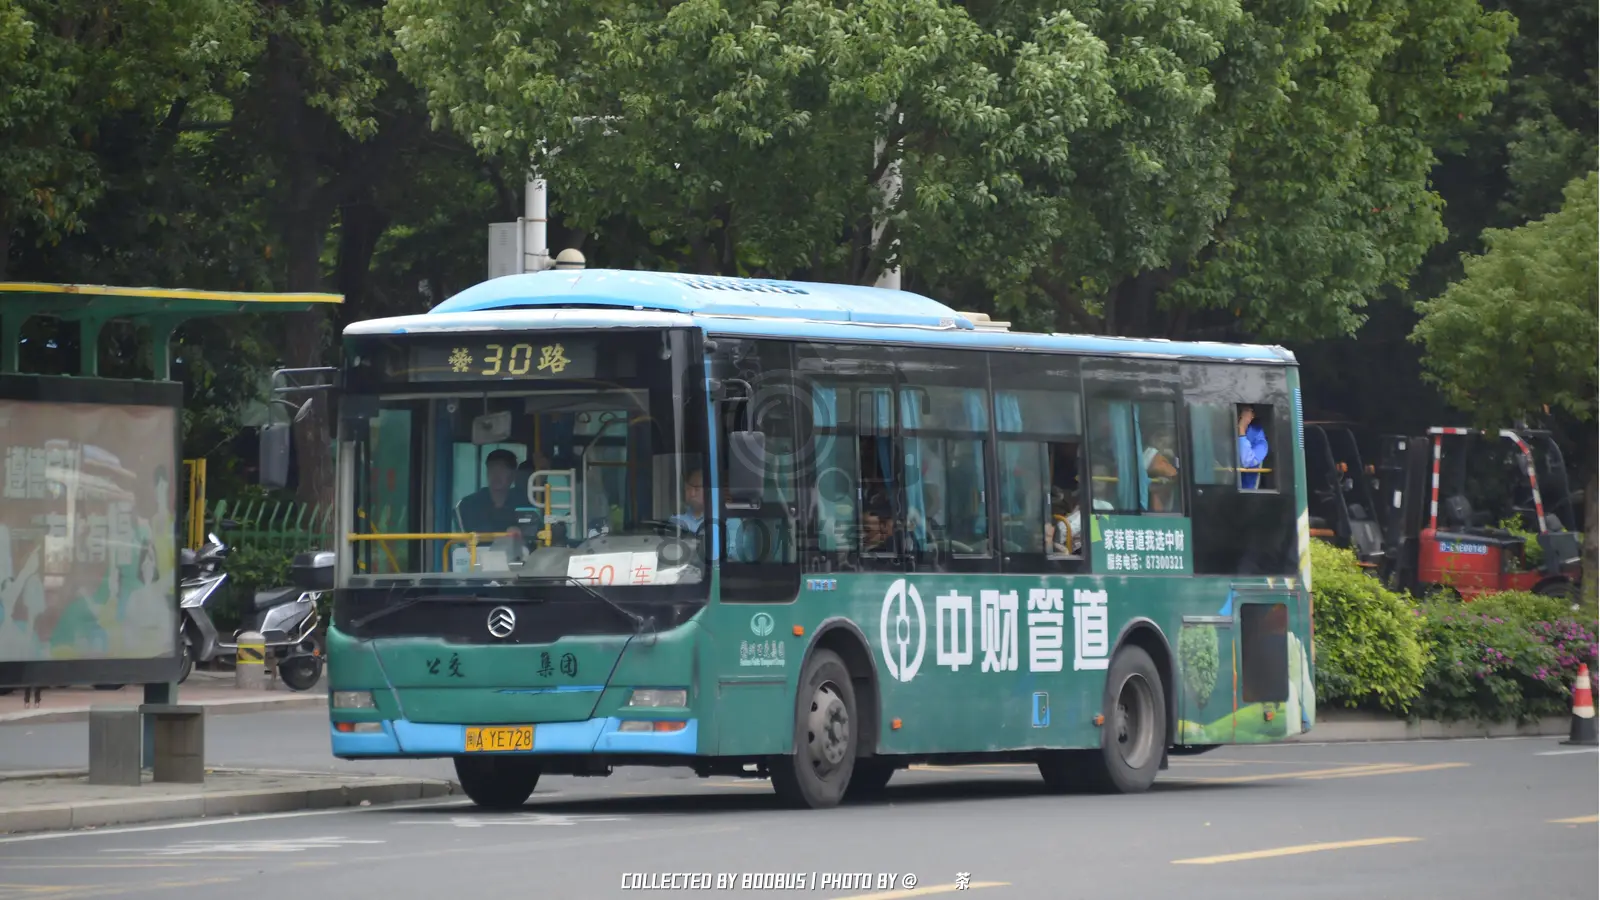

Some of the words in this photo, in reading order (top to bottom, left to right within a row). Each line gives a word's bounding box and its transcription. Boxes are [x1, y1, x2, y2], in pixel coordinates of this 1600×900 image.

[481, 343, 572, 376] 30路
[1104, 529, 1185, 552] 家装管道我选中财
[936, 588, 1110, 673] 中财管道
